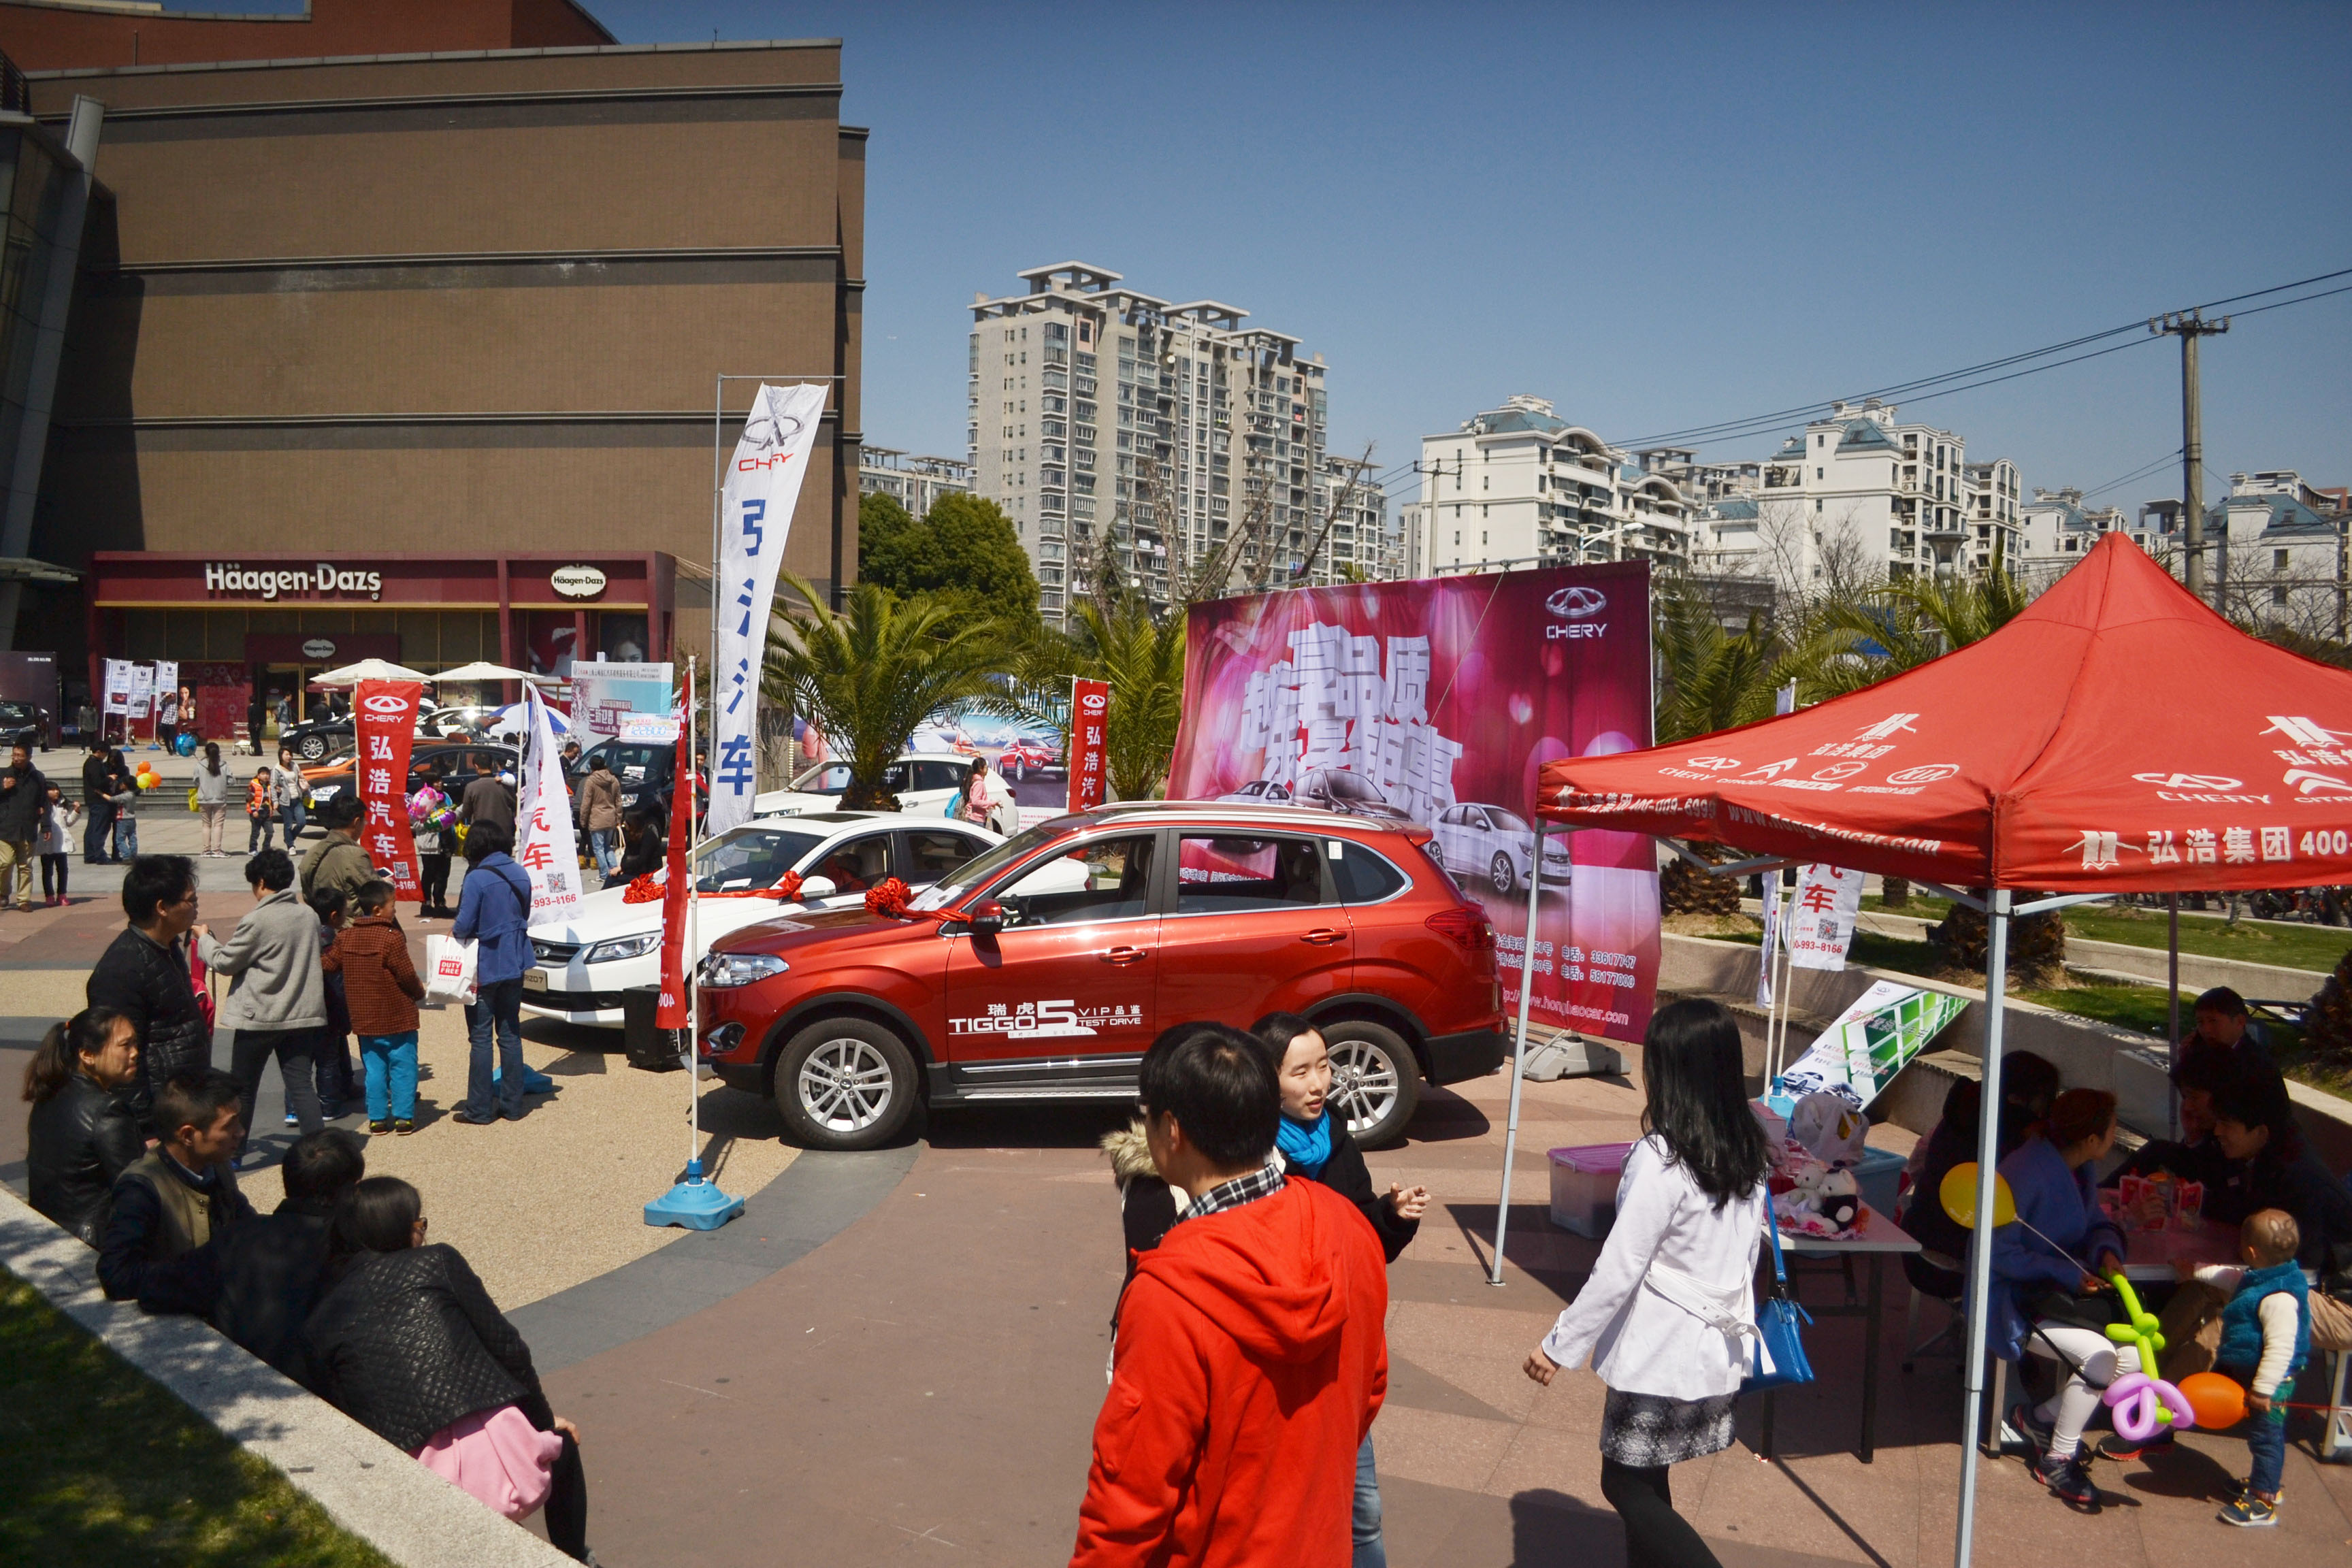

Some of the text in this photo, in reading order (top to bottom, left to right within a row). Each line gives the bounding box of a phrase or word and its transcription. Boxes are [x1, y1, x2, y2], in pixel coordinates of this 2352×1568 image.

[206, 563, 382, 599] Häagen-Dazs
[553, 576, 604, 586] Häagen-Dazs
[1546, 623, 1607, 638] CHERY
[365, 714, 404, 723] CHERY
[1658, 767, 1717, 781] CHERY
[368, 735, 398, 858] 弘浩汽车
[2156, 790, 2272, 804] CHERY
[2147, 826, 2291, 864] 弘浩集团
[1590, 950, 1636, 969] 33617747
[1589, 968, 1635, 988] 58177000
[949, 1000, 1077, 1032] TIGGO 5
[987, 1002, 1035, 1016] 瑞虎
[1079, 1004, 1141, 1016] VIP 品鉴
[1110, 1017, 1141, 1026] DRIVE
